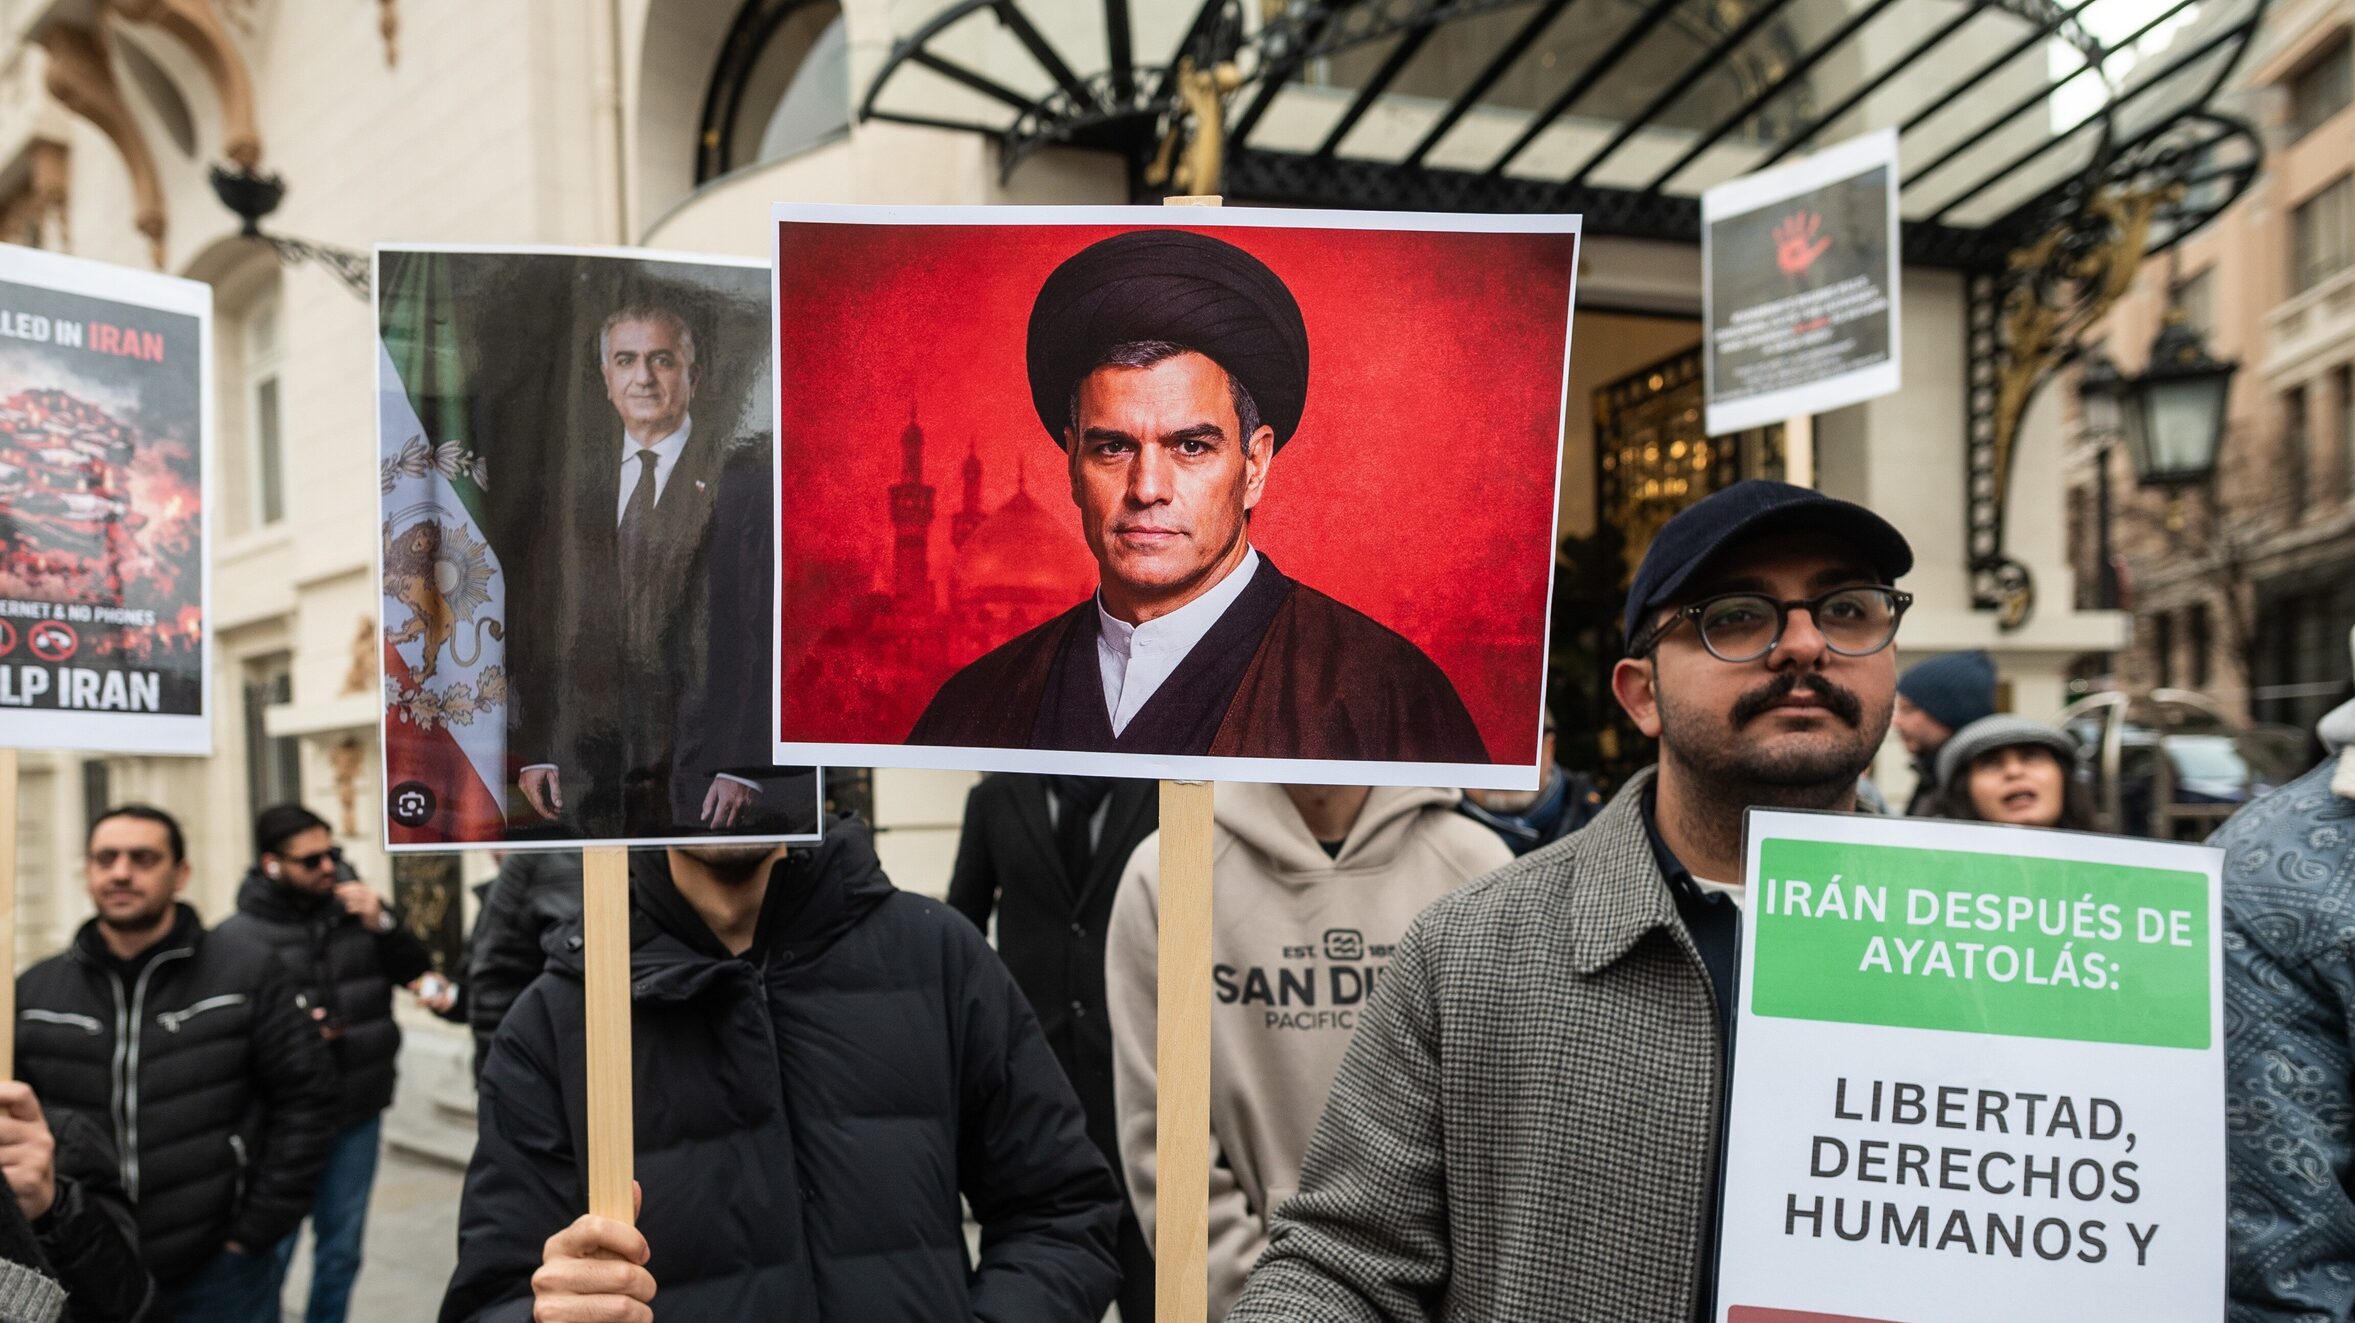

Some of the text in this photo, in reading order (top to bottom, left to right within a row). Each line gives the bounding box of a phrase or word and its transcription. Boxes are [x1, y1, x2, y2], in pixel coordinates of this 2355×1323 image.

[0, 310, 164, 362] LED IN IRAN
[53, 603, 66, 620] &
[68, 604, 92, 622] NO
[94, 606, 156, 626] PHONES
[58, 667, 160, 712] IRAN
[1766, 875, 2193, 947] IRÁN DESPUÉS DE
[1213, 963, 1384, 1007] SAN DI
[1858, 936, 2121, 991] AYATOLÁS:
[1265, 1010, 1353, 1030] PACIFIC
[1834, 1077, 2137, 1153] LIBERTAD,
[1810, 1135, 2140, 1205] DERECHOS
[1784, 1193, 2160, 1267] HUMANOS Y
